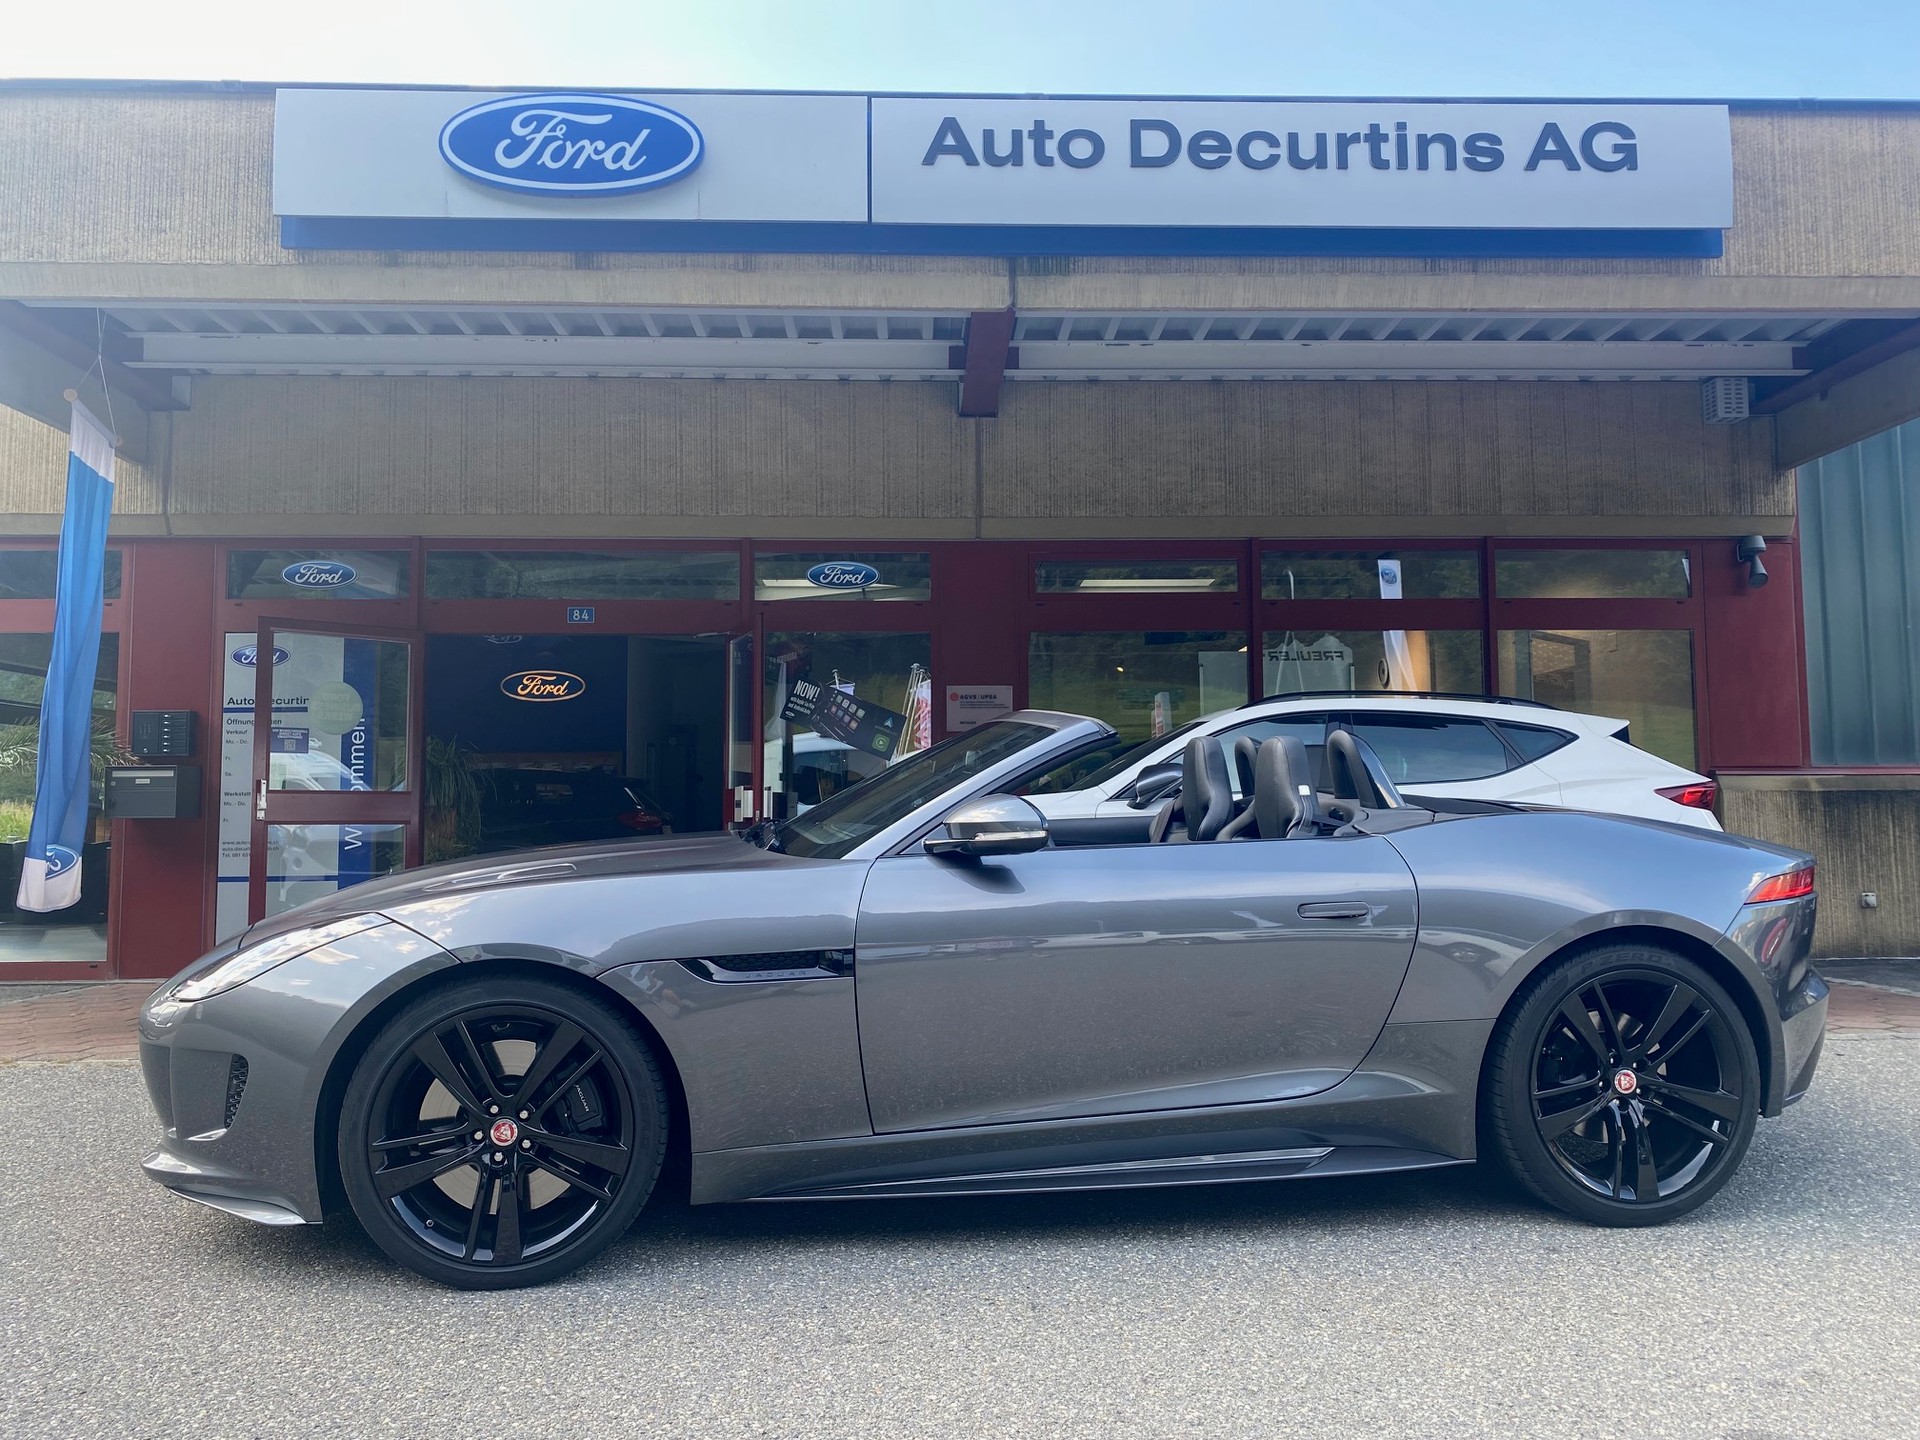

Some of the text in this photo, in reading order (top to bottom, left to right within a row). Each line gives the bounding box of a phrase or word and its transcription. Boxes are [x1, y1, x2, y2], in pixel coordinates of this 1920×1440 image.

[493, 109, 651, 171] Ford
[922, 116, 1640, 173] Auto Decurtins AG
[294, 564, 344, 584] Ford
[819, 564, 867, 585] Ford
[572, 609, 589, 621] 84
[516, 674, 569, 696] Ford
[793, 679, 821, 702] NOW!
[227, 697, 255, 705] Auto
[573, 1084, 590, 1112] JAGUAR
